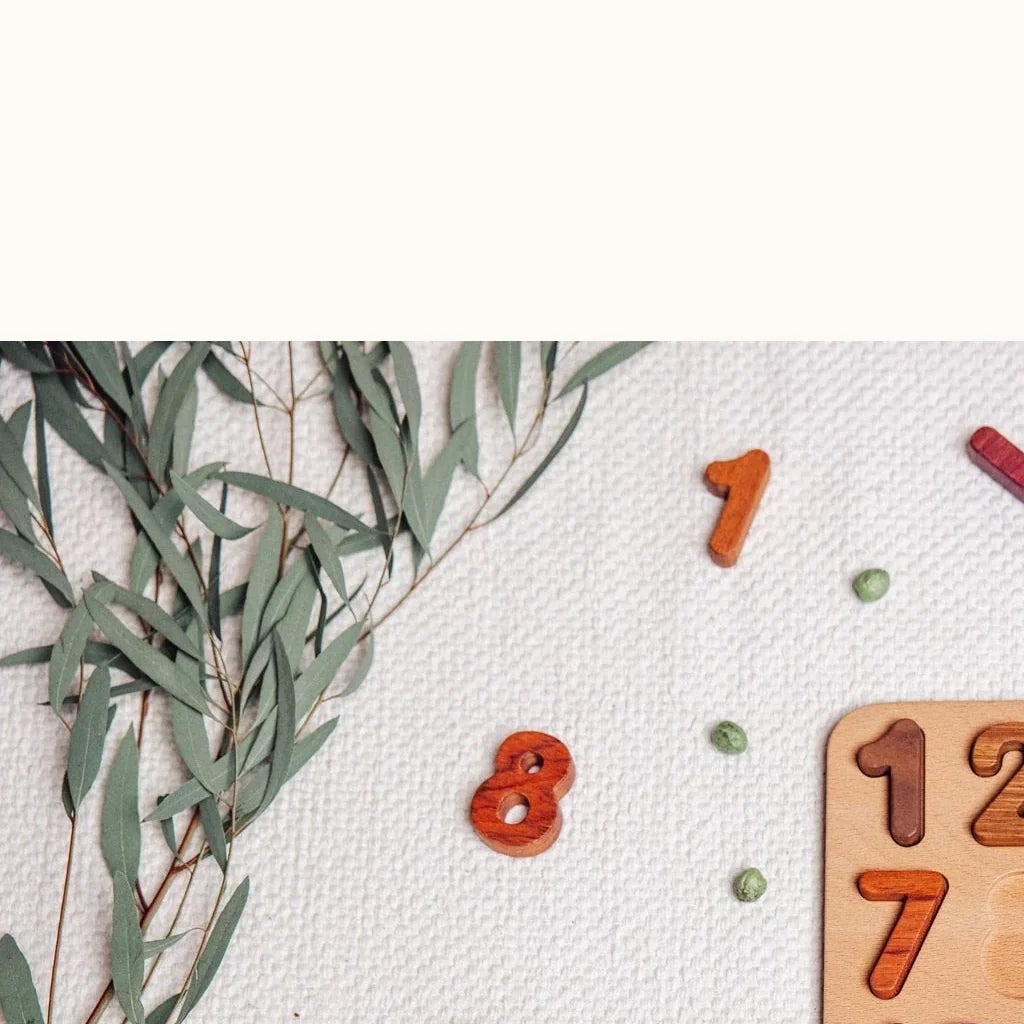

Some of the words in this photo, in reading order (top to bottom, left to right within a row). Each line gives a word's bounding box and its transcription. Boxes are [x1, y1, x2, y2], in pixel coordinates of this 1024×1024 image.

[703, 449, 772, 567] 1
[470, 730, 574, 858] 8
[856, 718, 925, 847] 1
[857, 870, 950, 1000] 7
